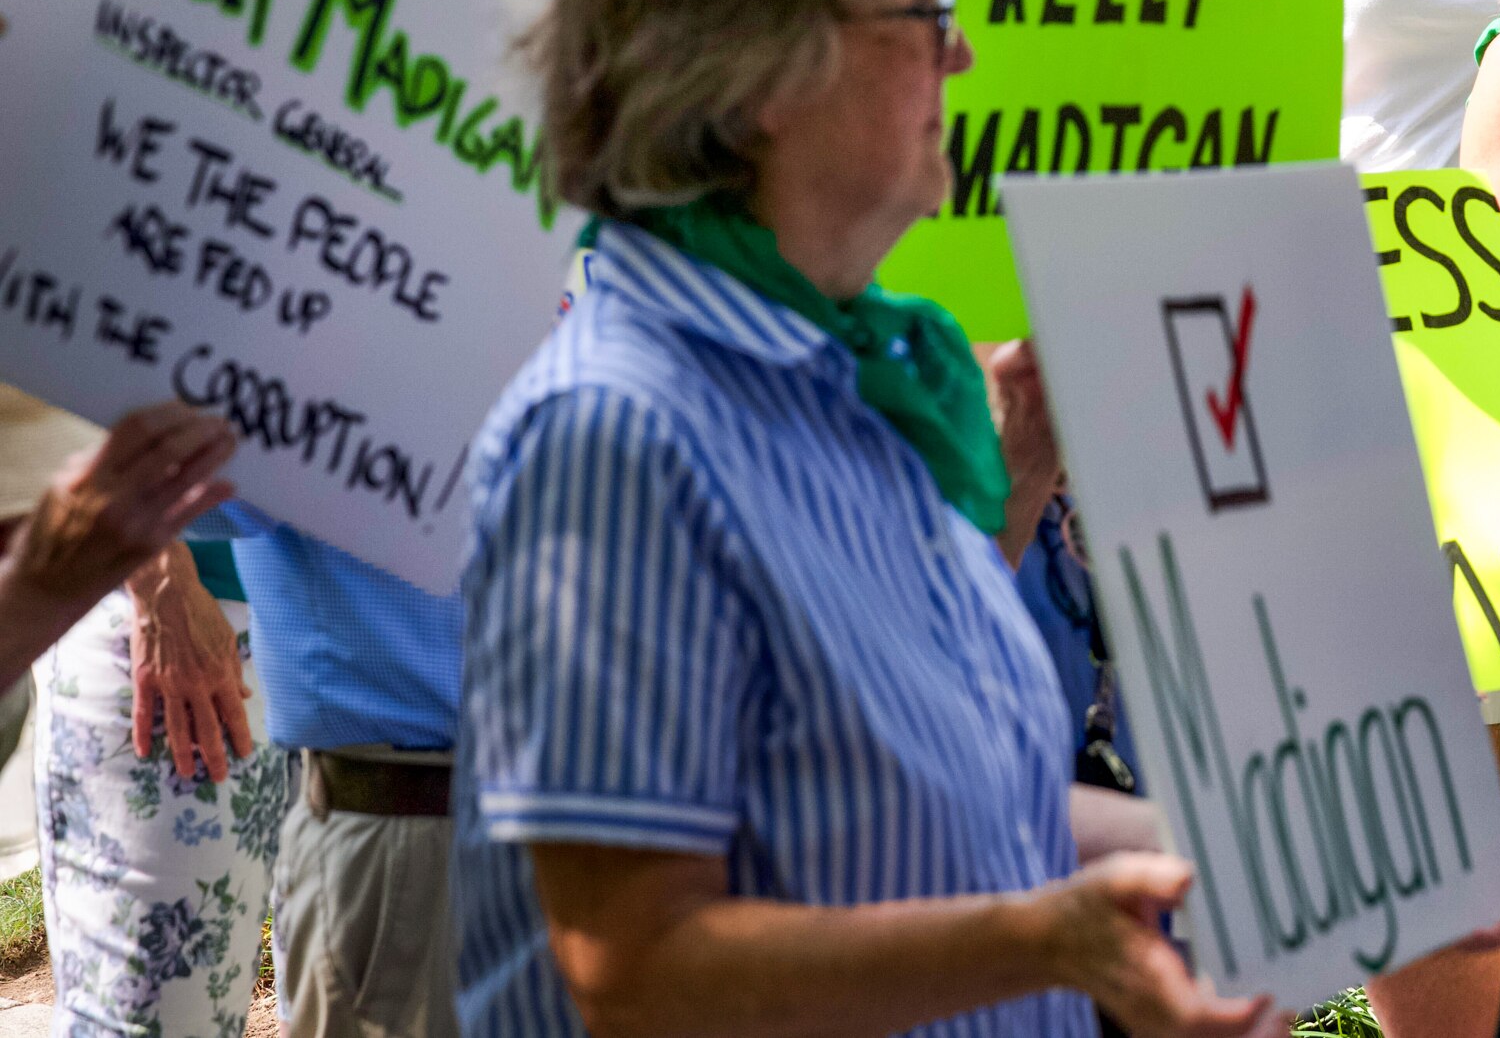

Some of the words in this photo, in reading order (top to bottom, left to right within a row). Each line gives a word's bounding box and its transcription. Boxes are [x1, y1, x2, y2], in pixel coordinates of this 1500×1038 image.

[0, 247, 82, 341] ITH
[94, 97, 175, 184] WE
[187, 137, 276, 239] THE
[286, 194, 449, 322] PEOPLE
[107, 204, 189, 277] ARE
[197, 238, 272, 311] FED
[279, 288, 332, 335] UP
[1119, 534, 1475, 974] Madigan
